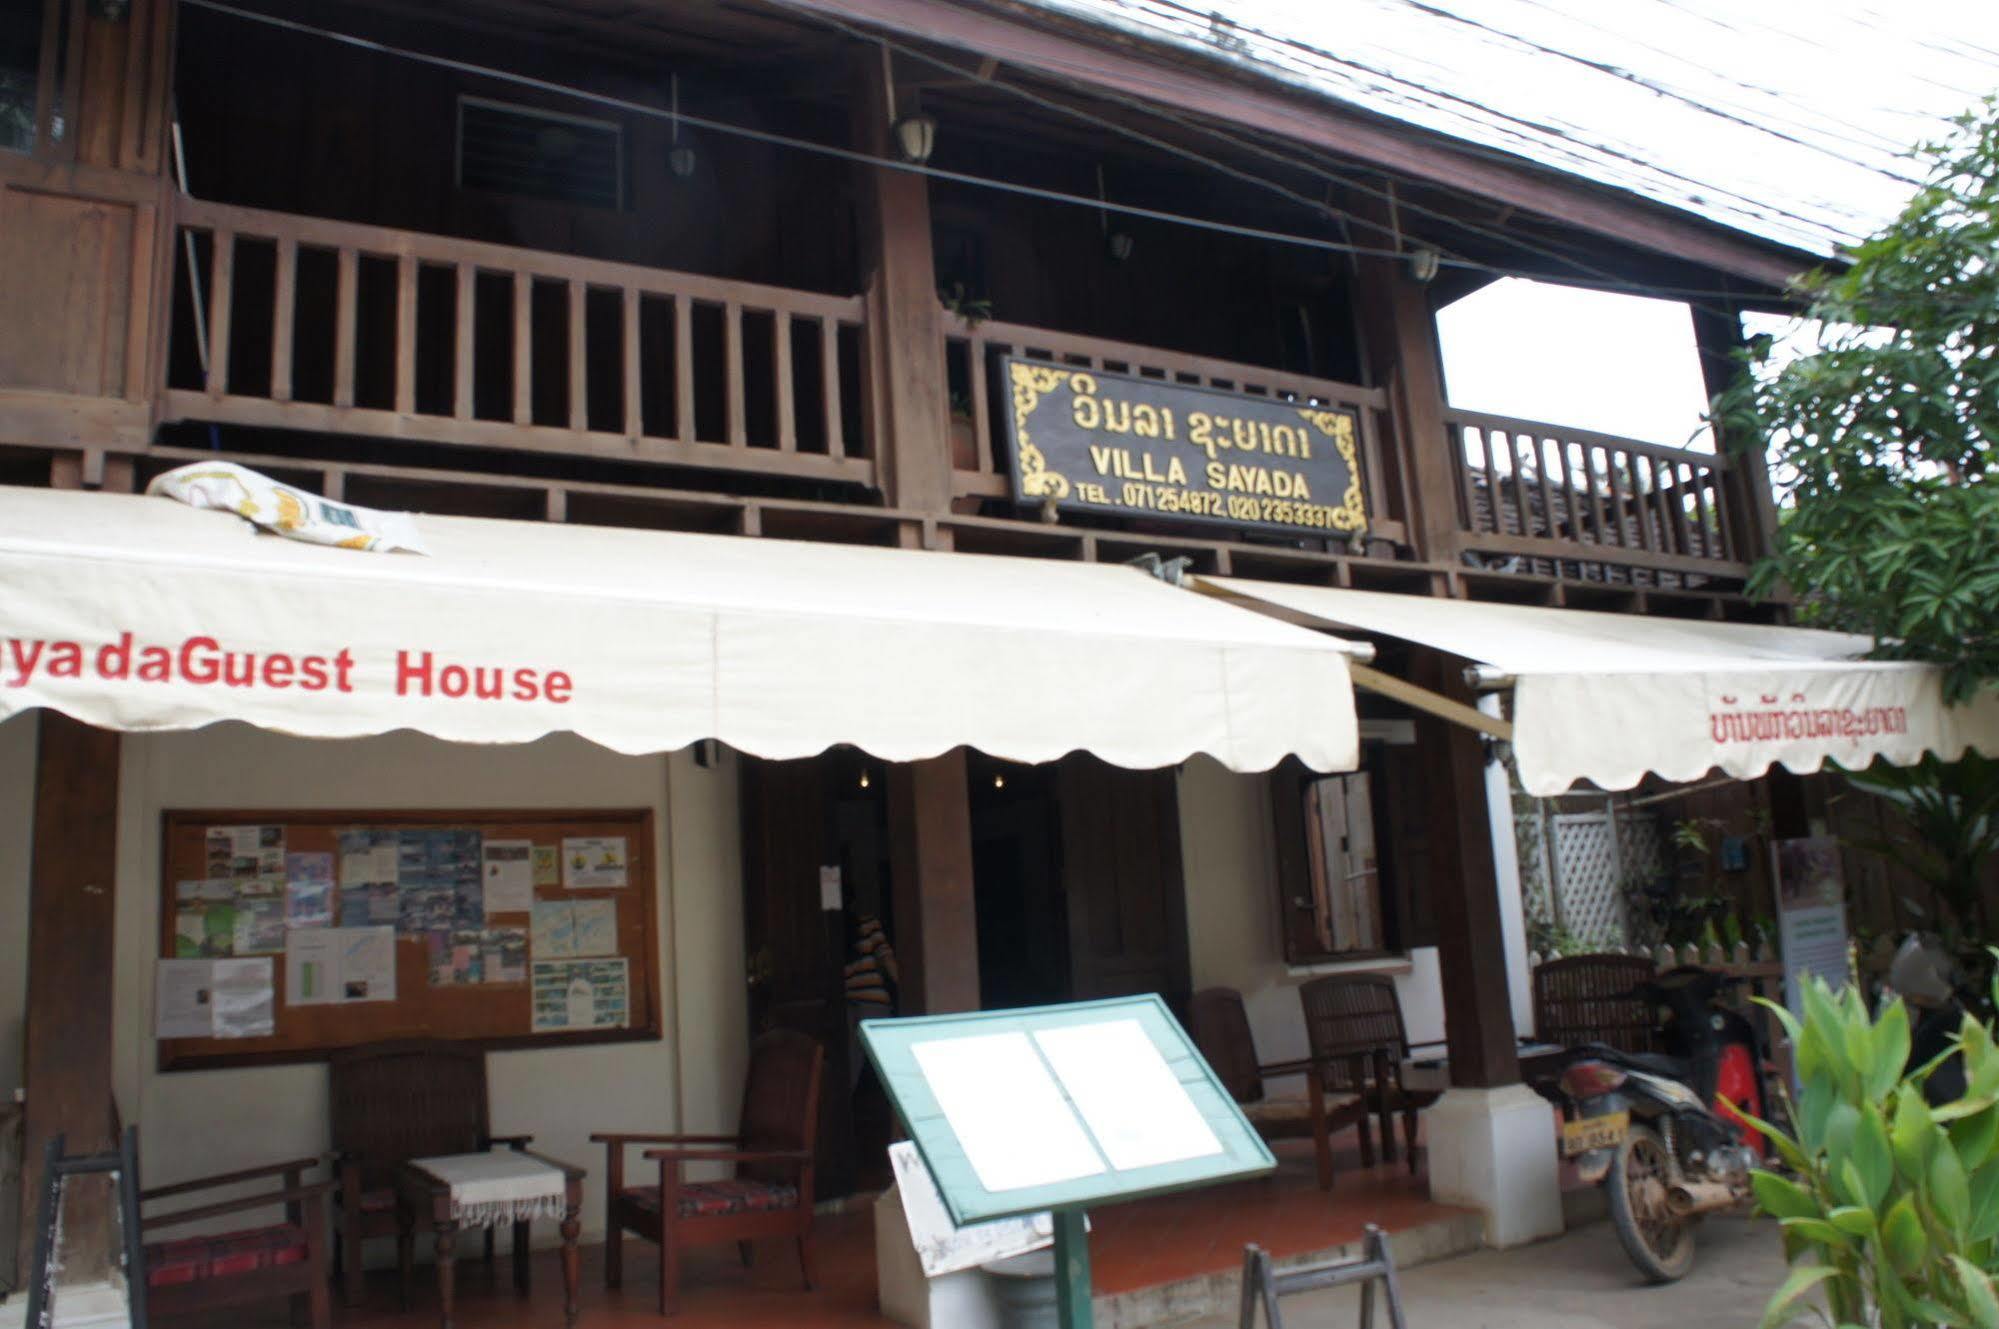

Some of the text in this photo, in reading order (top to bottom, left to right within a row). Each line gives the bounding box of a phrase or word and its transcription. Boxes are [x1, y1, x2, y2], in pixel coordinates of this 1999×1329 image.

[1090, 446, 1311, 499] VILLA SAYADA
[396, 650, 573, 703] House
